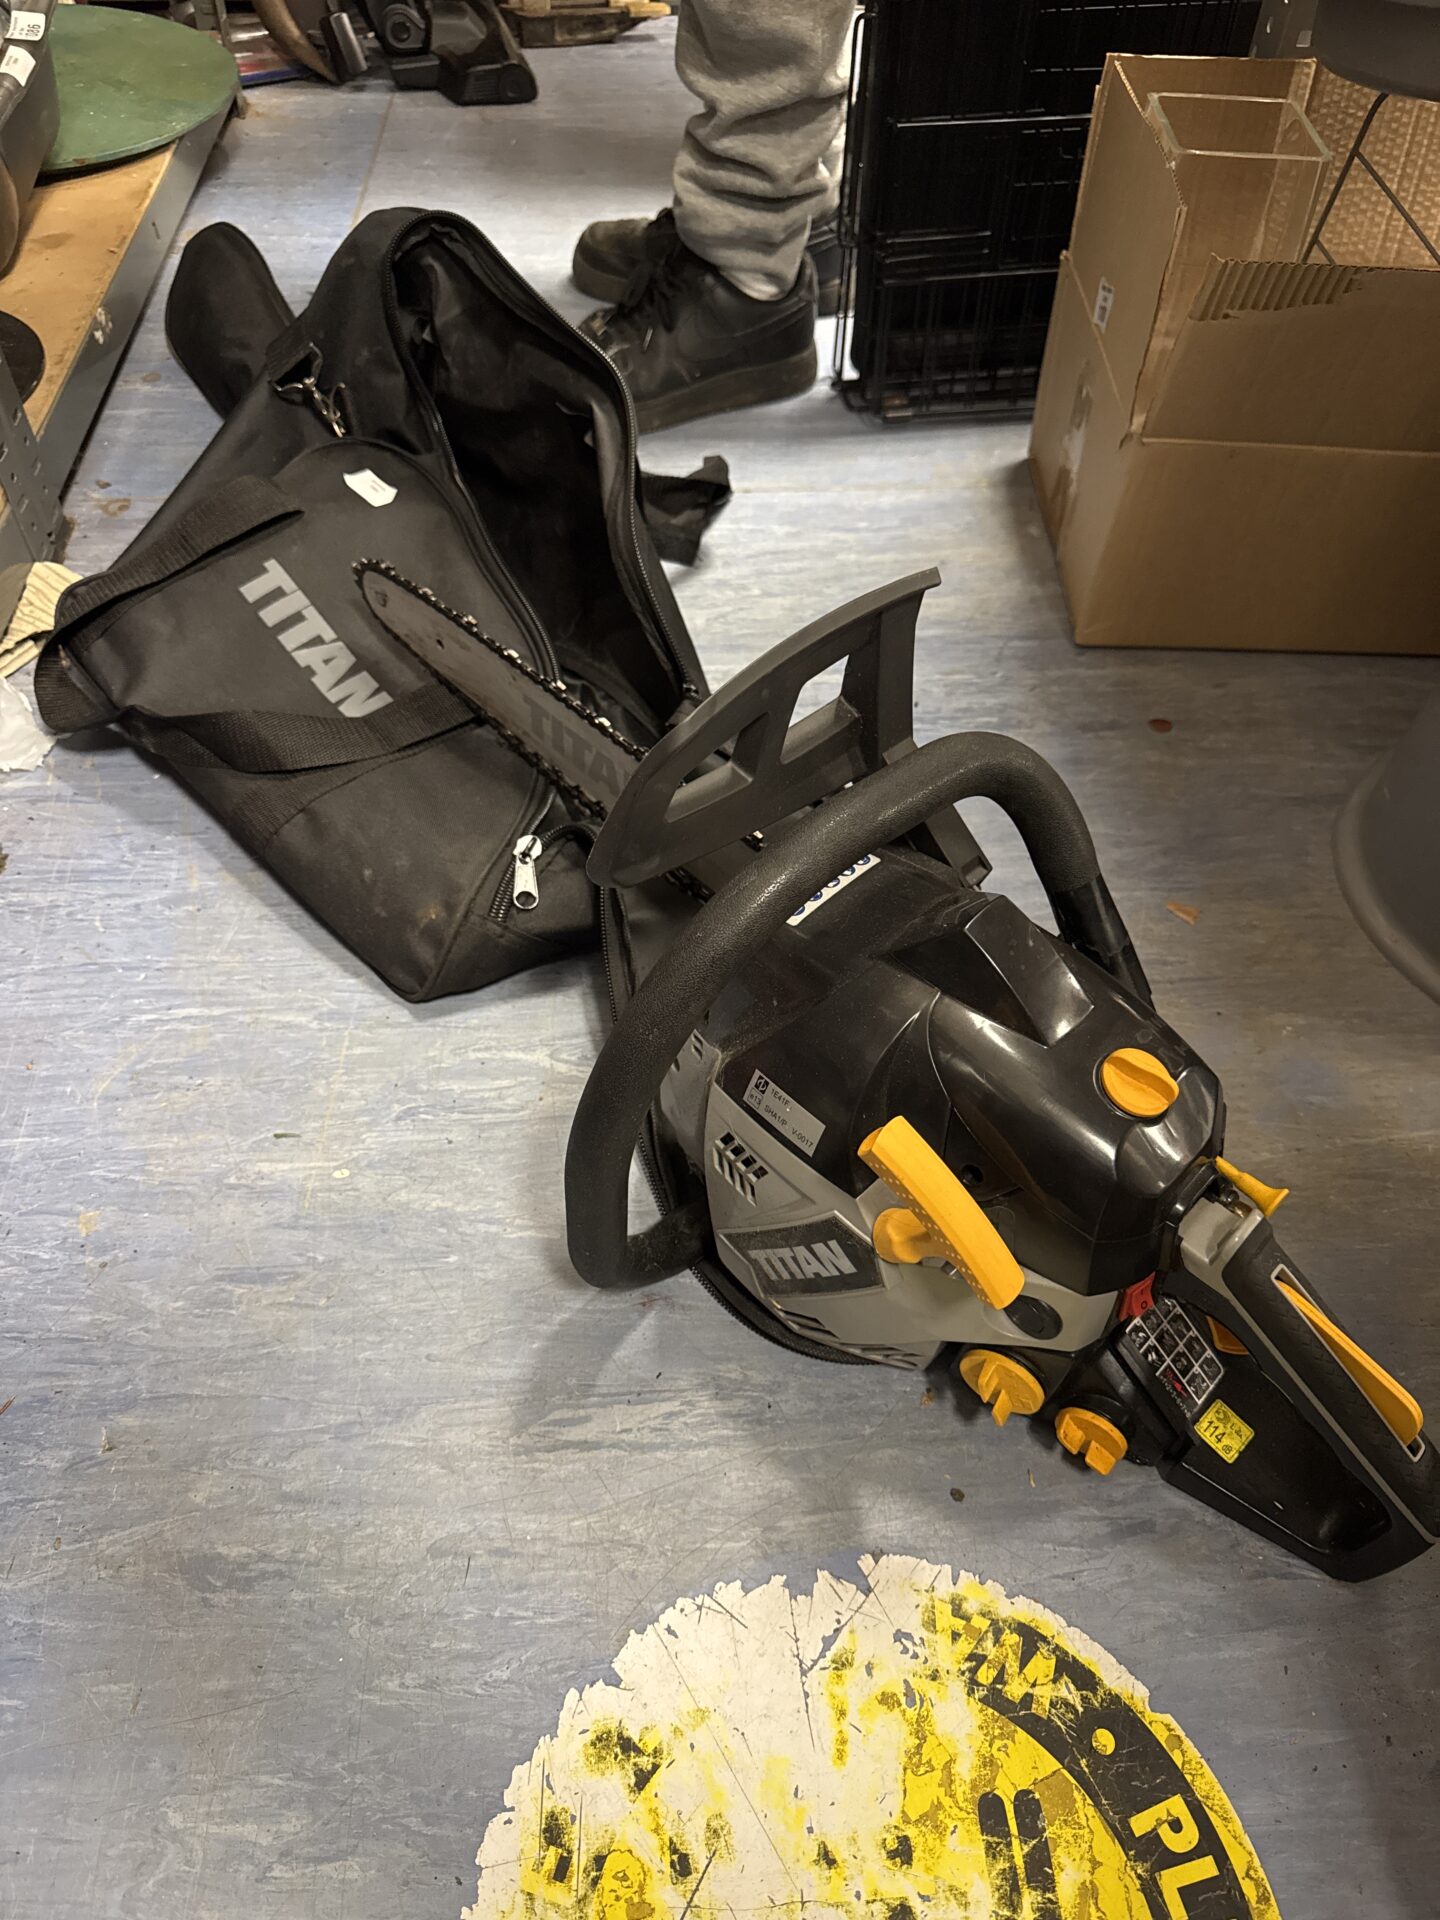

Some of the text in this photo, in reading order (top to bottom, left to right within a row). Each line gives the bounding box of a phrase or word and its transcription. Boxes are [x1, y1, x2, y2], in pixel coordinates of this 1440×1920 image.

[239, 559, 394, 718] TITAN
[523, 697, 625, 798] TITA
[792, 1128, 813, 1148] V-0017
[748, 1240, 858, 1280] TITAN
[1203, 1421, 1233, 1455] 114 dB
[1127, 1793, 1225, 1920] PL
